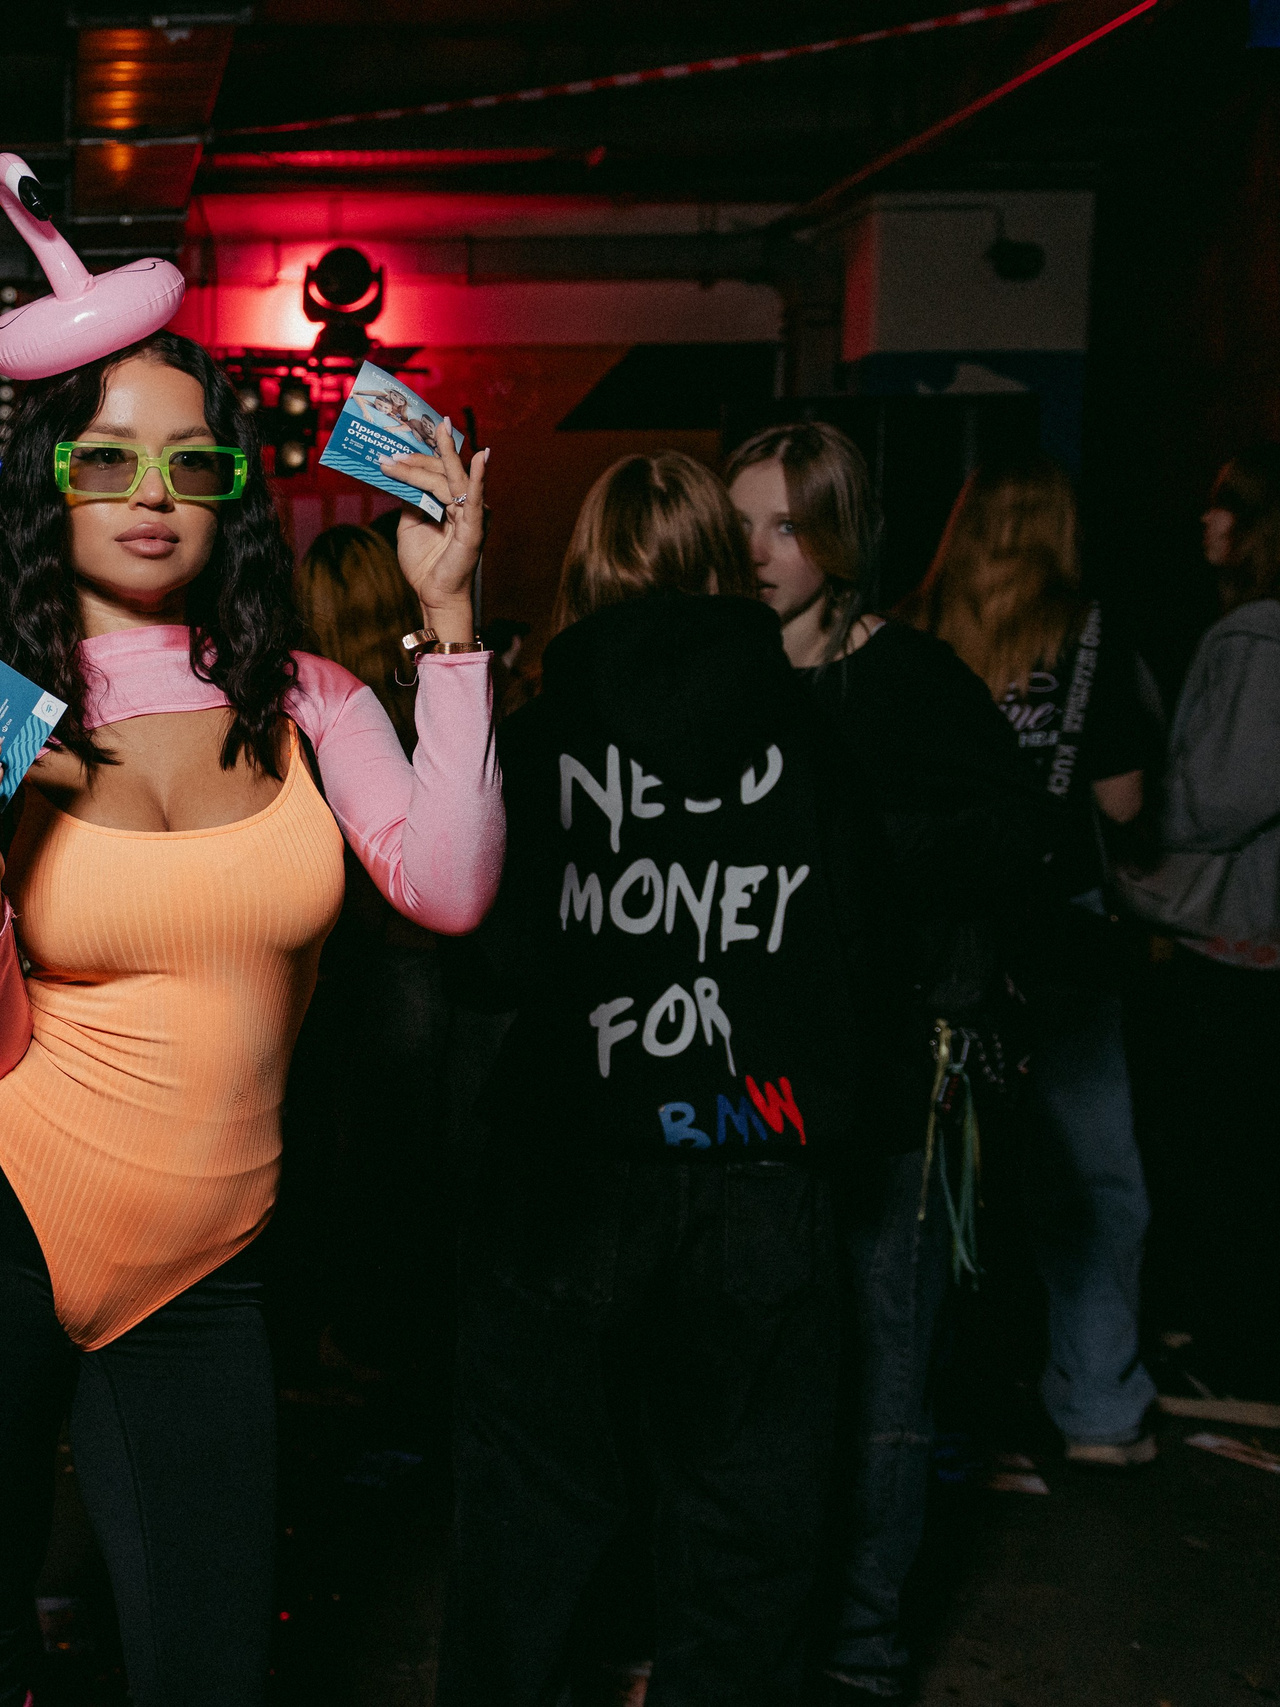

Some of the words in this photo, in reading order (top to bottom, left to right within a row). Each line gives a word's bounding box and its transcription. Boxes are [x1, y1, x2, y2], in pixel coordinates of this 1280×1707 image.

[348, 428, 399, 454] отдыхат
[559, 743, 783, 853] NED
[559, 857, 810, 963] MONEY
[589, 977, 736, 1077] FOR
[659, 1075, 806, 1148] BMW
